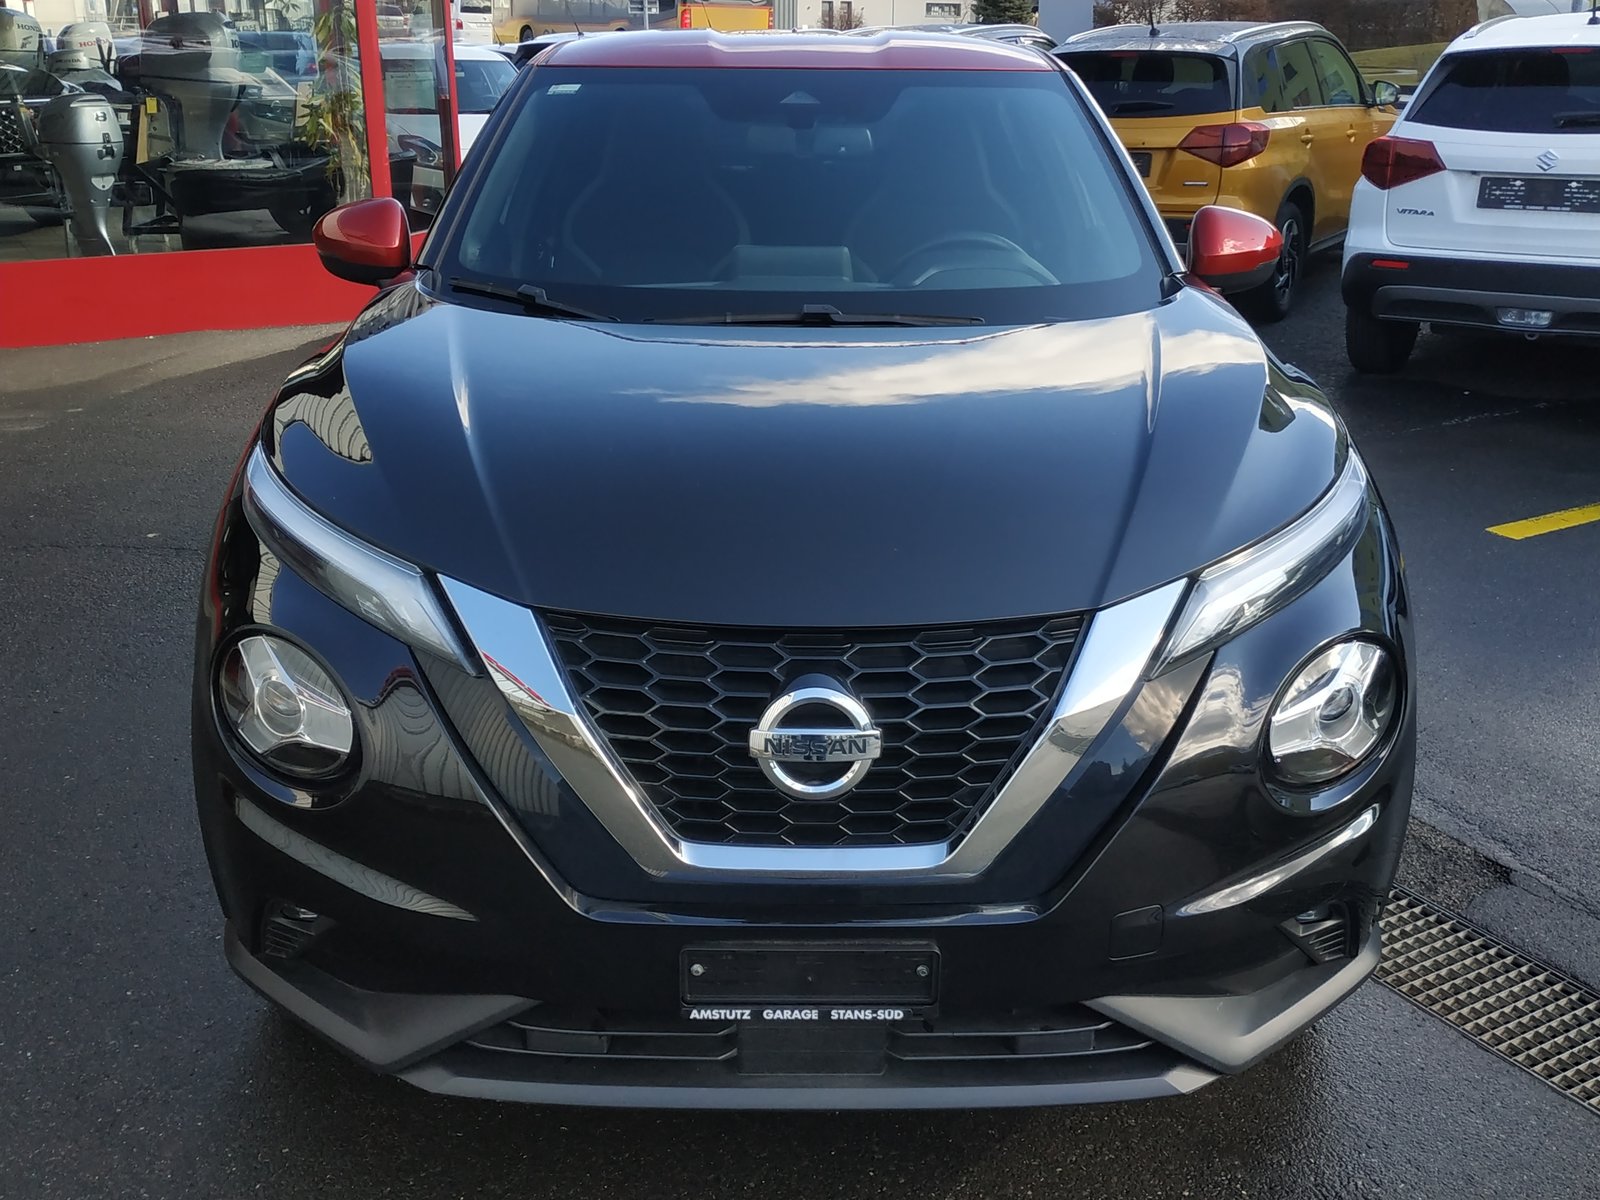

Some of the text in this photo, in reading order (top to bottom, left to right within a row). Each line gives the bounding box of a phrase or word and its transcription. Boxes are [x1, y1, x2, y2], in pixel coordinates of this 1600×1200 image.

[1396, 207, 1435, 216] VITARA
[763, 738, 867, 755] NISSAN
[689, 1008, 904, 1020] AMSTUTZ GARAGE STANS-SÜD
